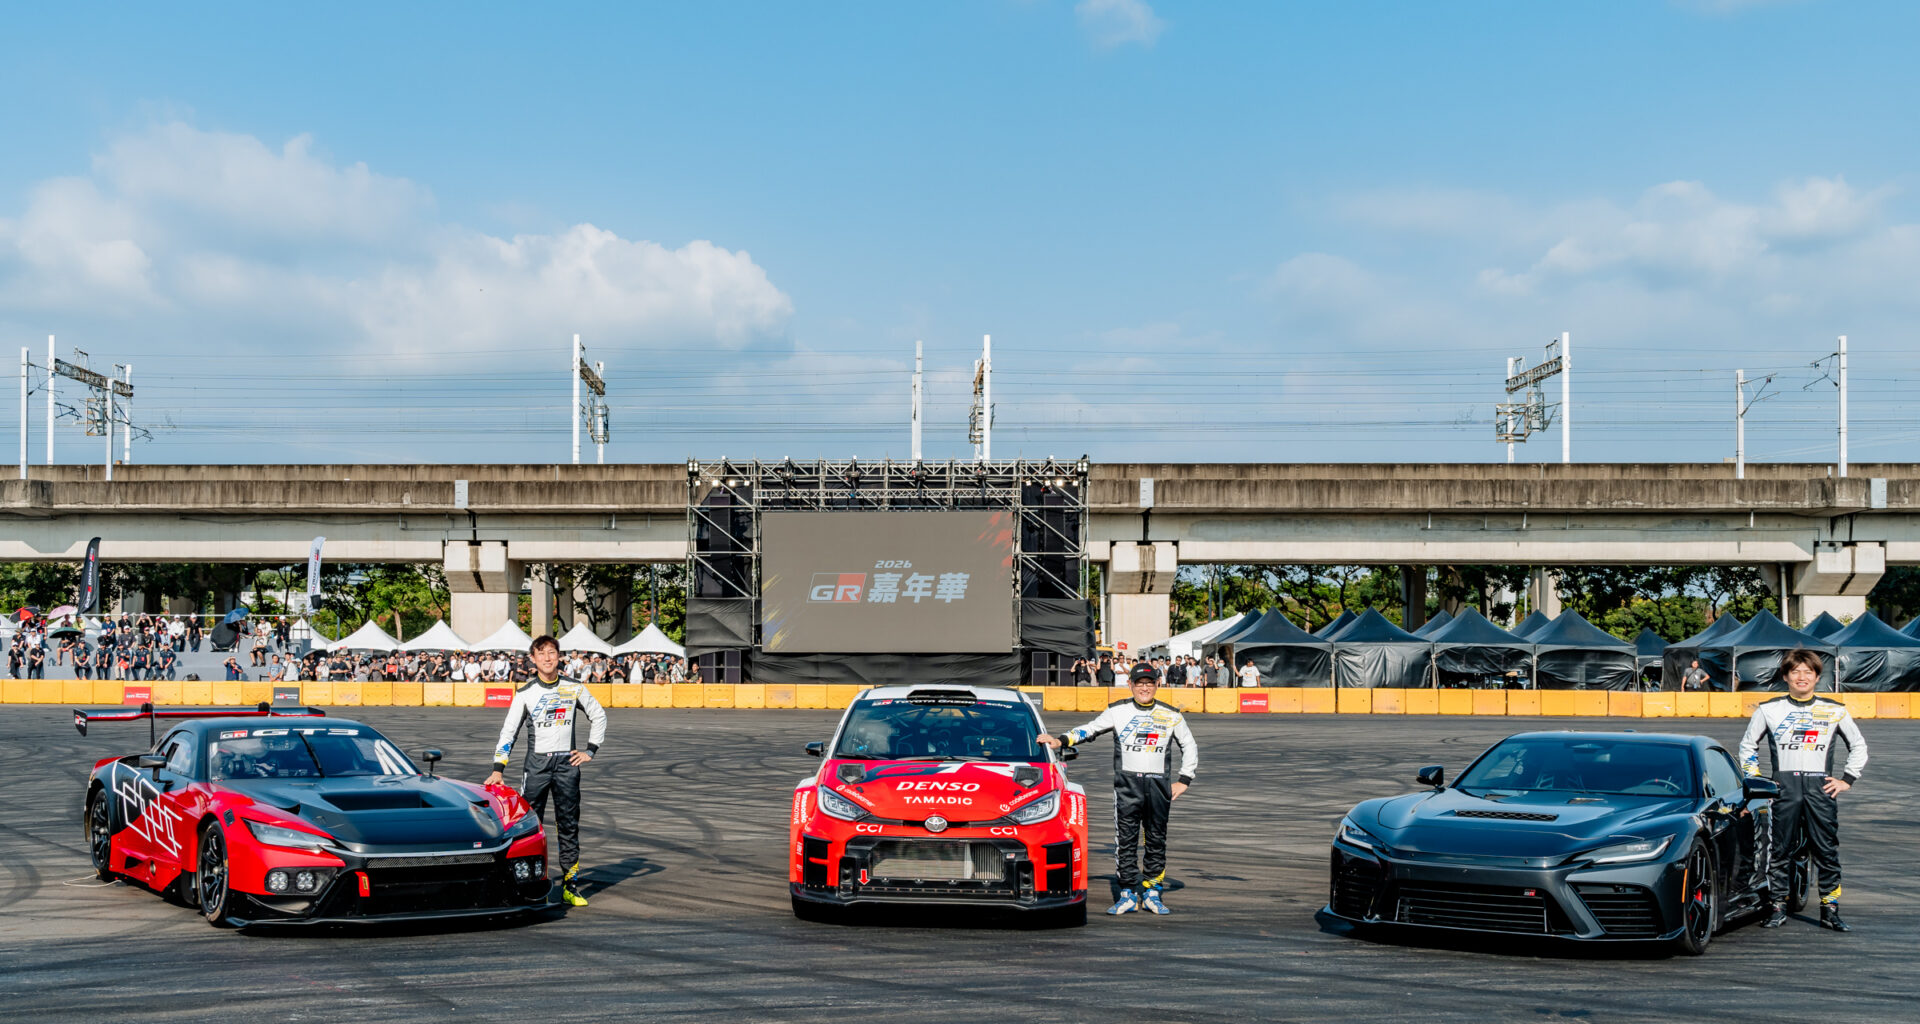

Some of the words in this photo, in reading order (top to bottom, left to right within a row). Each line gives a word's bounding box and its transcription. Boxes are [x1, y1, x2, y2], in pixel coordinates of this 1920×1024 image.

[874, 560, 913, 569] 2026
[810, 583, 862, 601] GR
[867, 572, 970, 603] 嘉年華
[546, 710, 566, 720] GR
[220, 730, 248, 739] GR
[252, 728, 359, 737] GT3
[1791, 733, 1818, 743] GR
[1134, 735, 1158, 745] GR
[896, 781, 981, 792] DENSO
[904, 796, 973, 806] TAMADIC
[856, 823, 883, 834] CCI
[990, 826, 1018, 836] CCI
